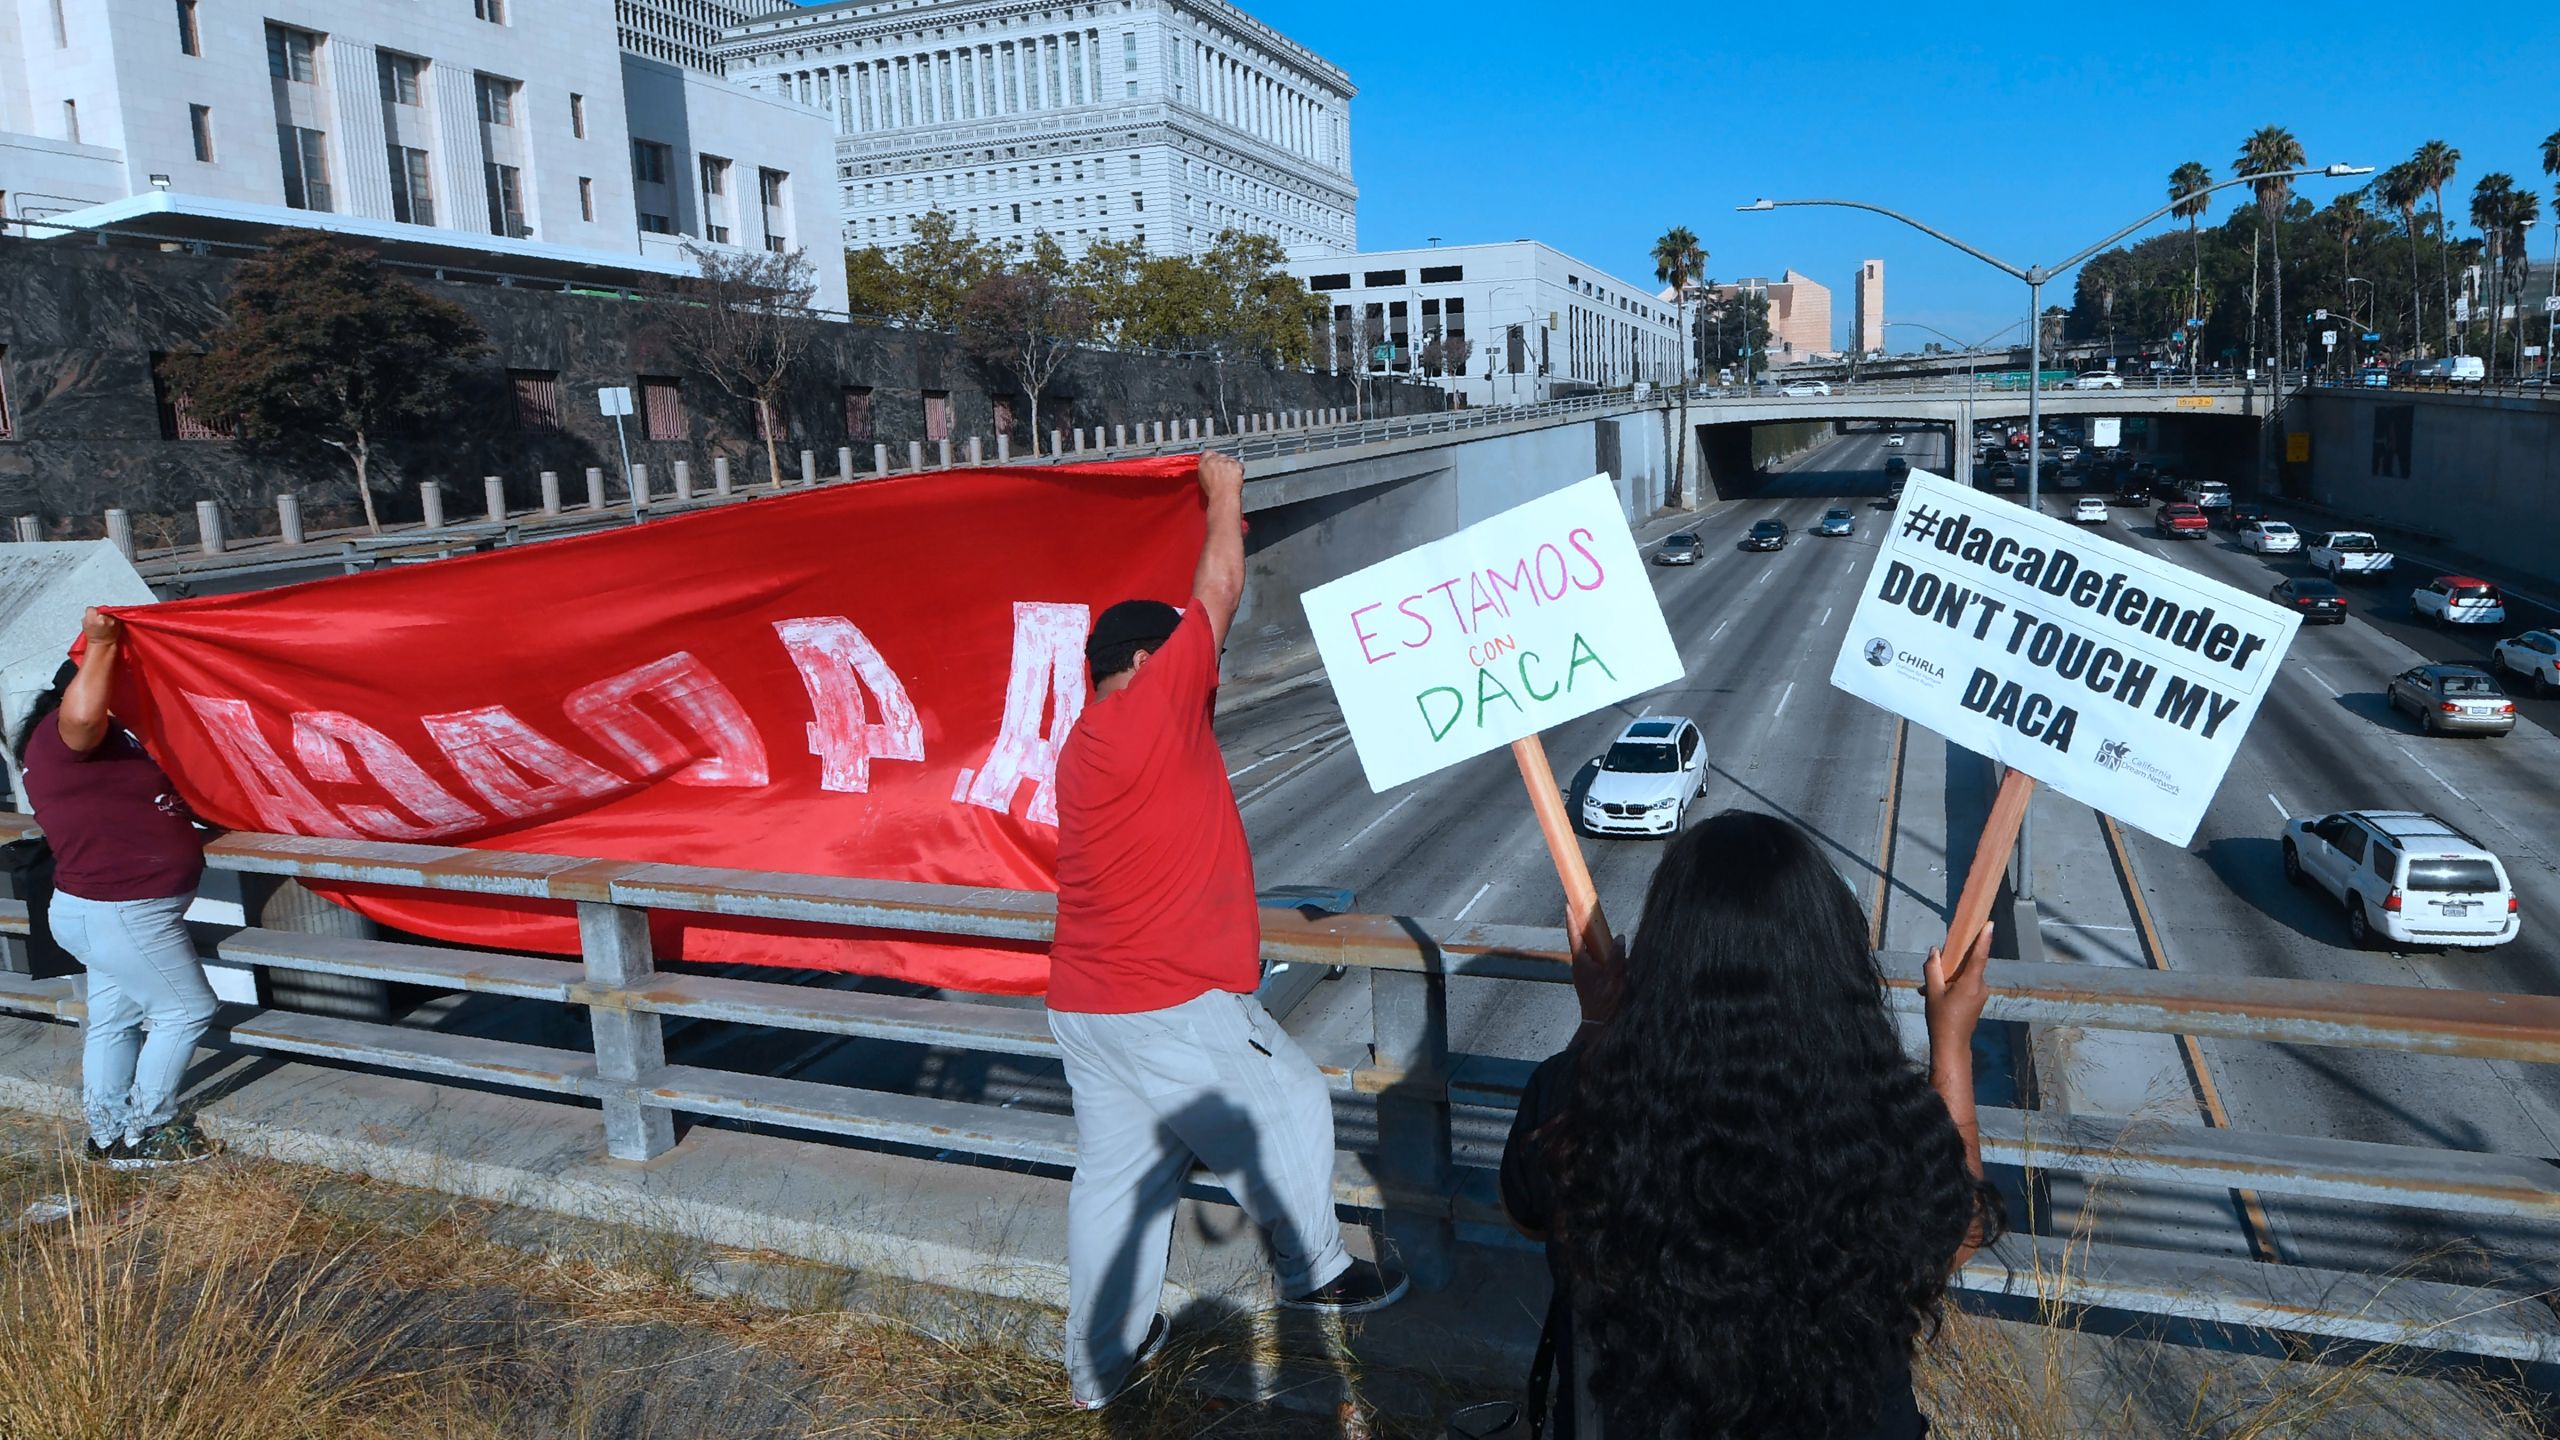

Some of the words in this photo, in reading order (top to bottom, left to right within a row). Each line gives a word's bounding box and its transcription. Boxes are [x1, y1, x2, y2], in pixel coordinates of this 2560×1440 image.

[1351, 528, 1605, 664] ESTAMOS
[1902, 504, 2265, 671] #dacaDefender
[1417, 633, 1617, 742] DACA
[1469, 634, 1515, 666] CON
[1878, 561, 2006, 640] DON'T
[2006, 608, 2157, 709] TOUCH
[2154, 675, 2240, 740] MY
[1898, 651, 1945, 679] CHIRLA
[1960, 667, 2079, 753] DACA
[2121, 762, 2147, 778] Dream
[2147, 773, 2180, 793] Network
[2131, 757, 2172, 780] California
